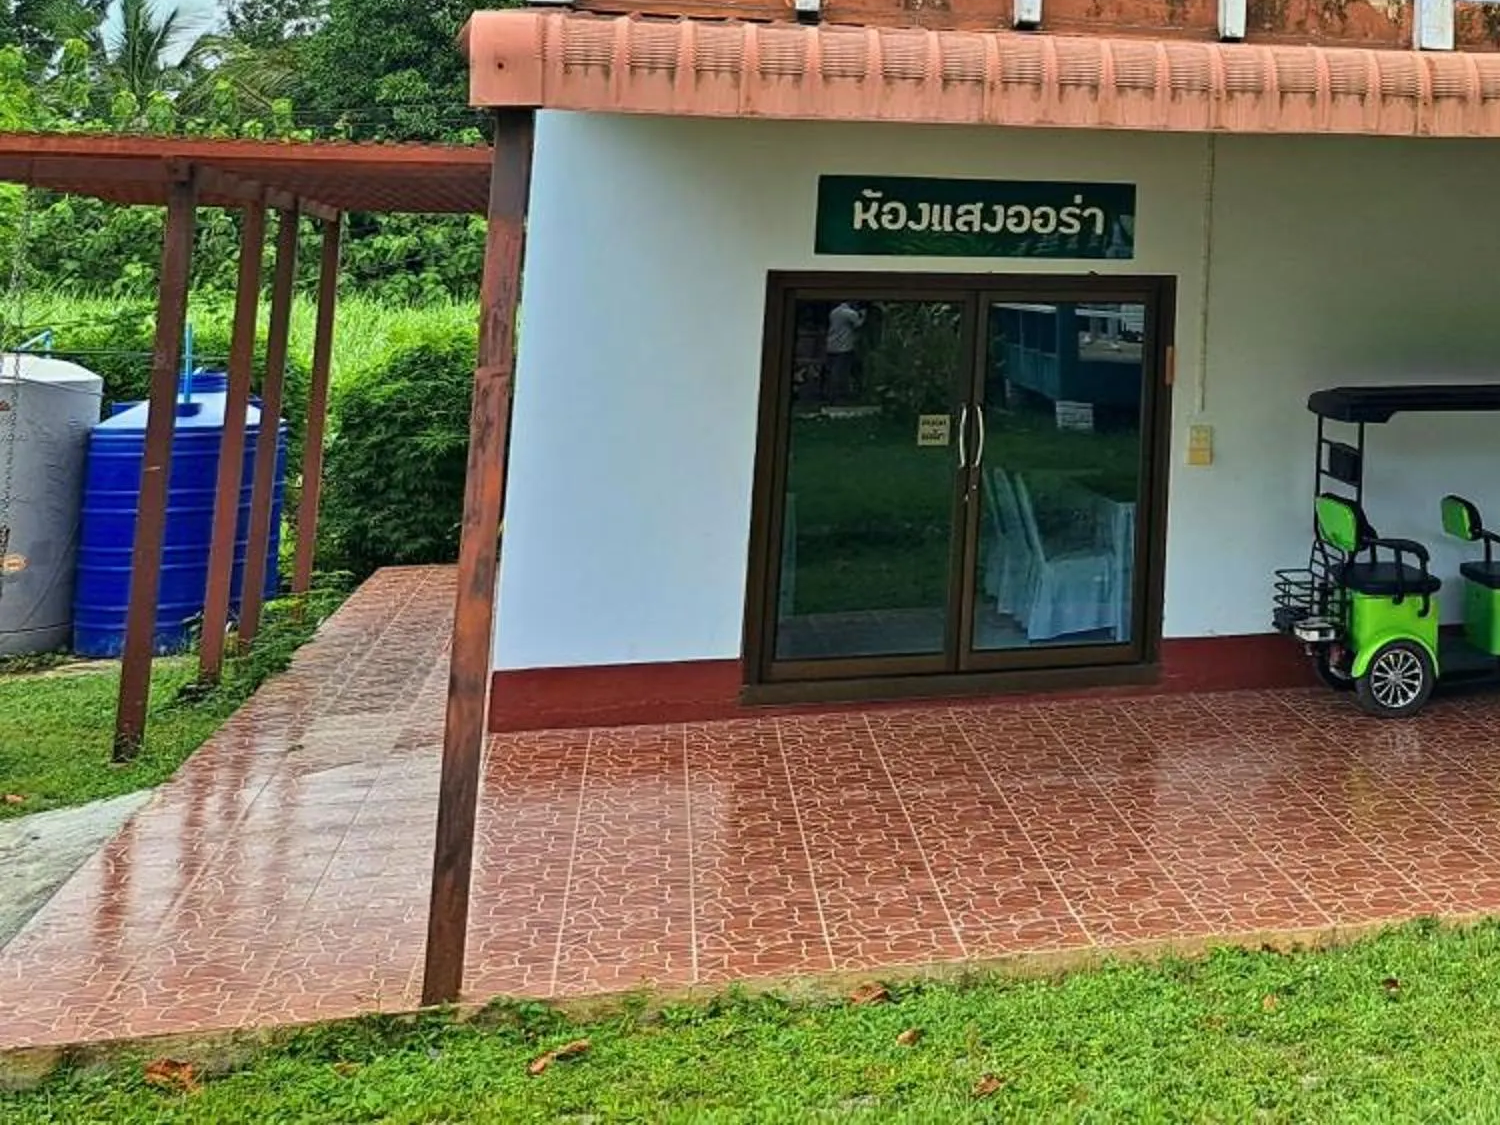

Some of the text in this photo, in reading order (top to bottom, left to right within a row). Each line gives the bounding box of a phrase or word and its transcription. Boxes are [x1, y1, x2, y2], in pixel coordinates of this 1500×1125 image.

[853, 188, 1105, 235] ห้องแสงออร่า
